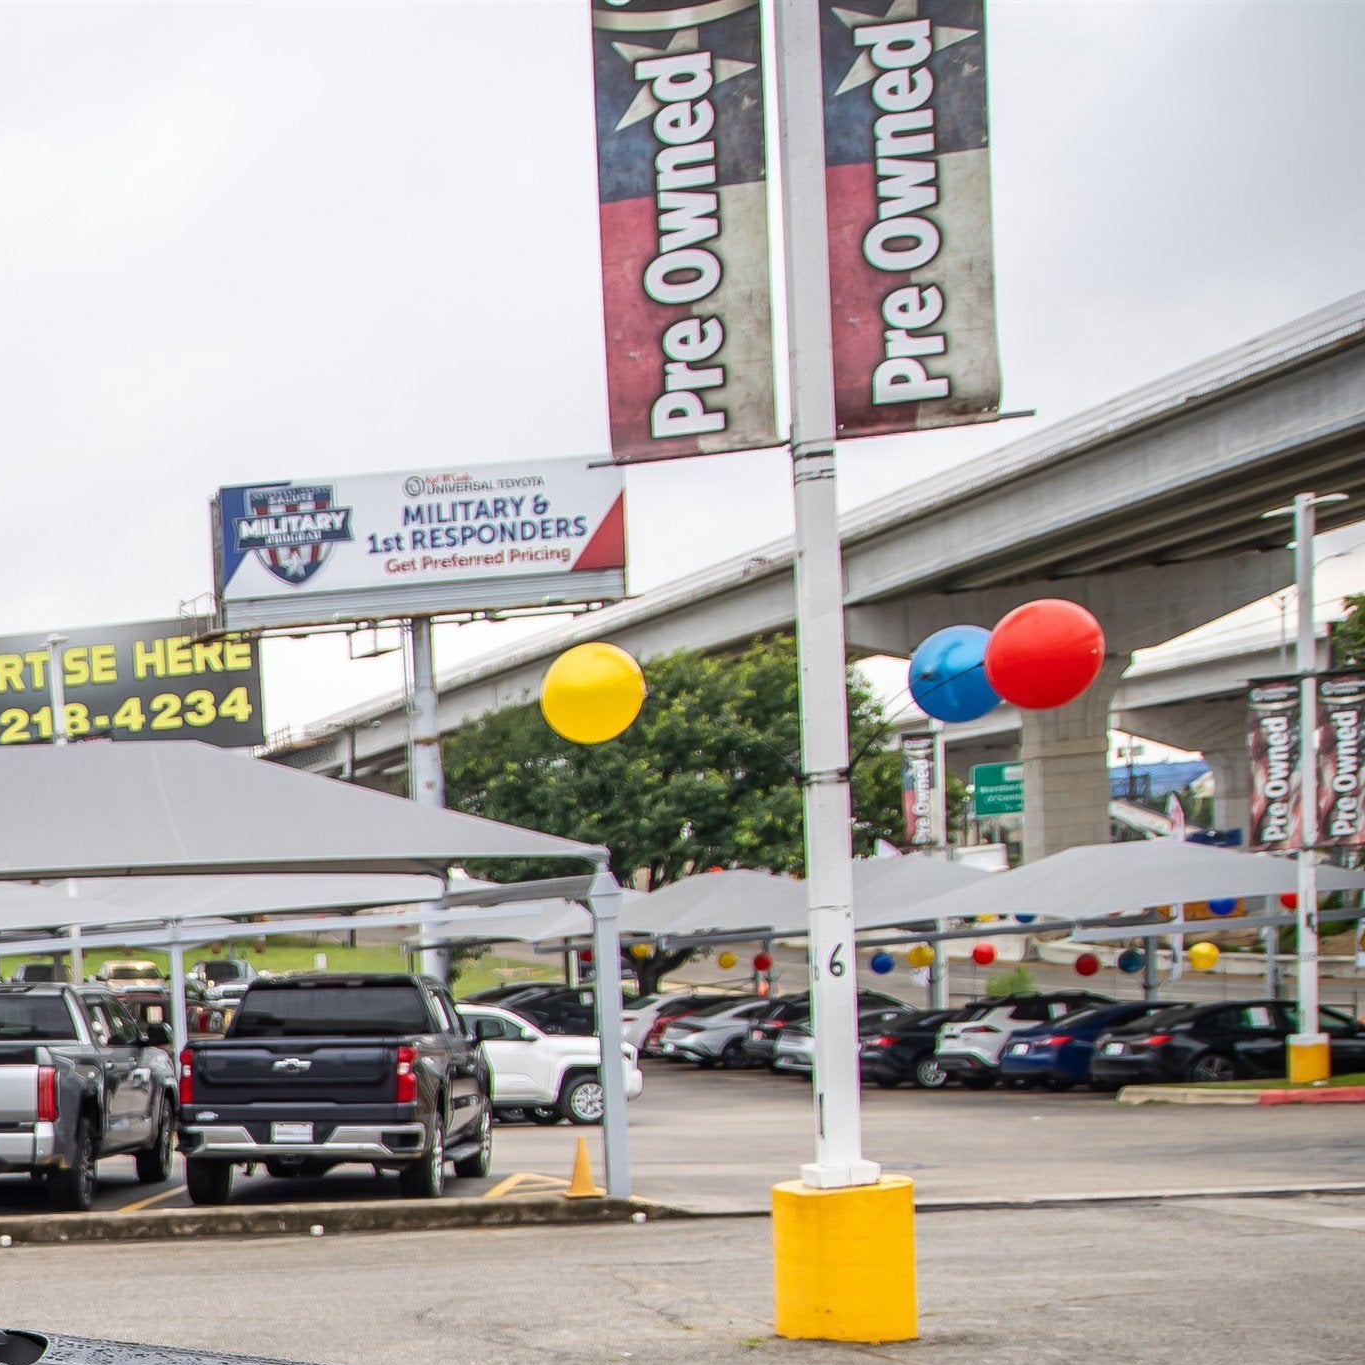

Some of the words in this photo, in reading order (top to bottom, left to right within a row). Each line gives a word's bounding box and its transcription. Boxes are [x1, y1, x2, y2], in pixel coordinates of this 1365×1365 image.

[854, 19, 942, 271] Owned
[635, 52, 722, 304] Owned
[872, 285, 949, 405] Pre
[650, 317, 725, 439] Pre
[427, 479, 495, 495] UNIVERSAL
[498, 476, 545, 489] TOYOTA
[240, 512, 346, 539] MILITARY
[403, 494, 526, 526] MILITARY
[533, 493, 549, 515] &
[368, 532, 404, 554] 1st
[411, 514, 588, 550] RESPONDERS
[386, 556, 418, 574] Get
[422, 550, 505, 571] Preferred
[510, 546, 572, 564] Pricing
[133, 633, 252, 681] HERE
[1260, 716, 1290, 799] Owned
[1330, 710, 1359, 793] Owned
[1261, 802, 1289, 842] Pre
[1330, 796, 1357, 836] Pre
[829, 943, 844, 977] 6
